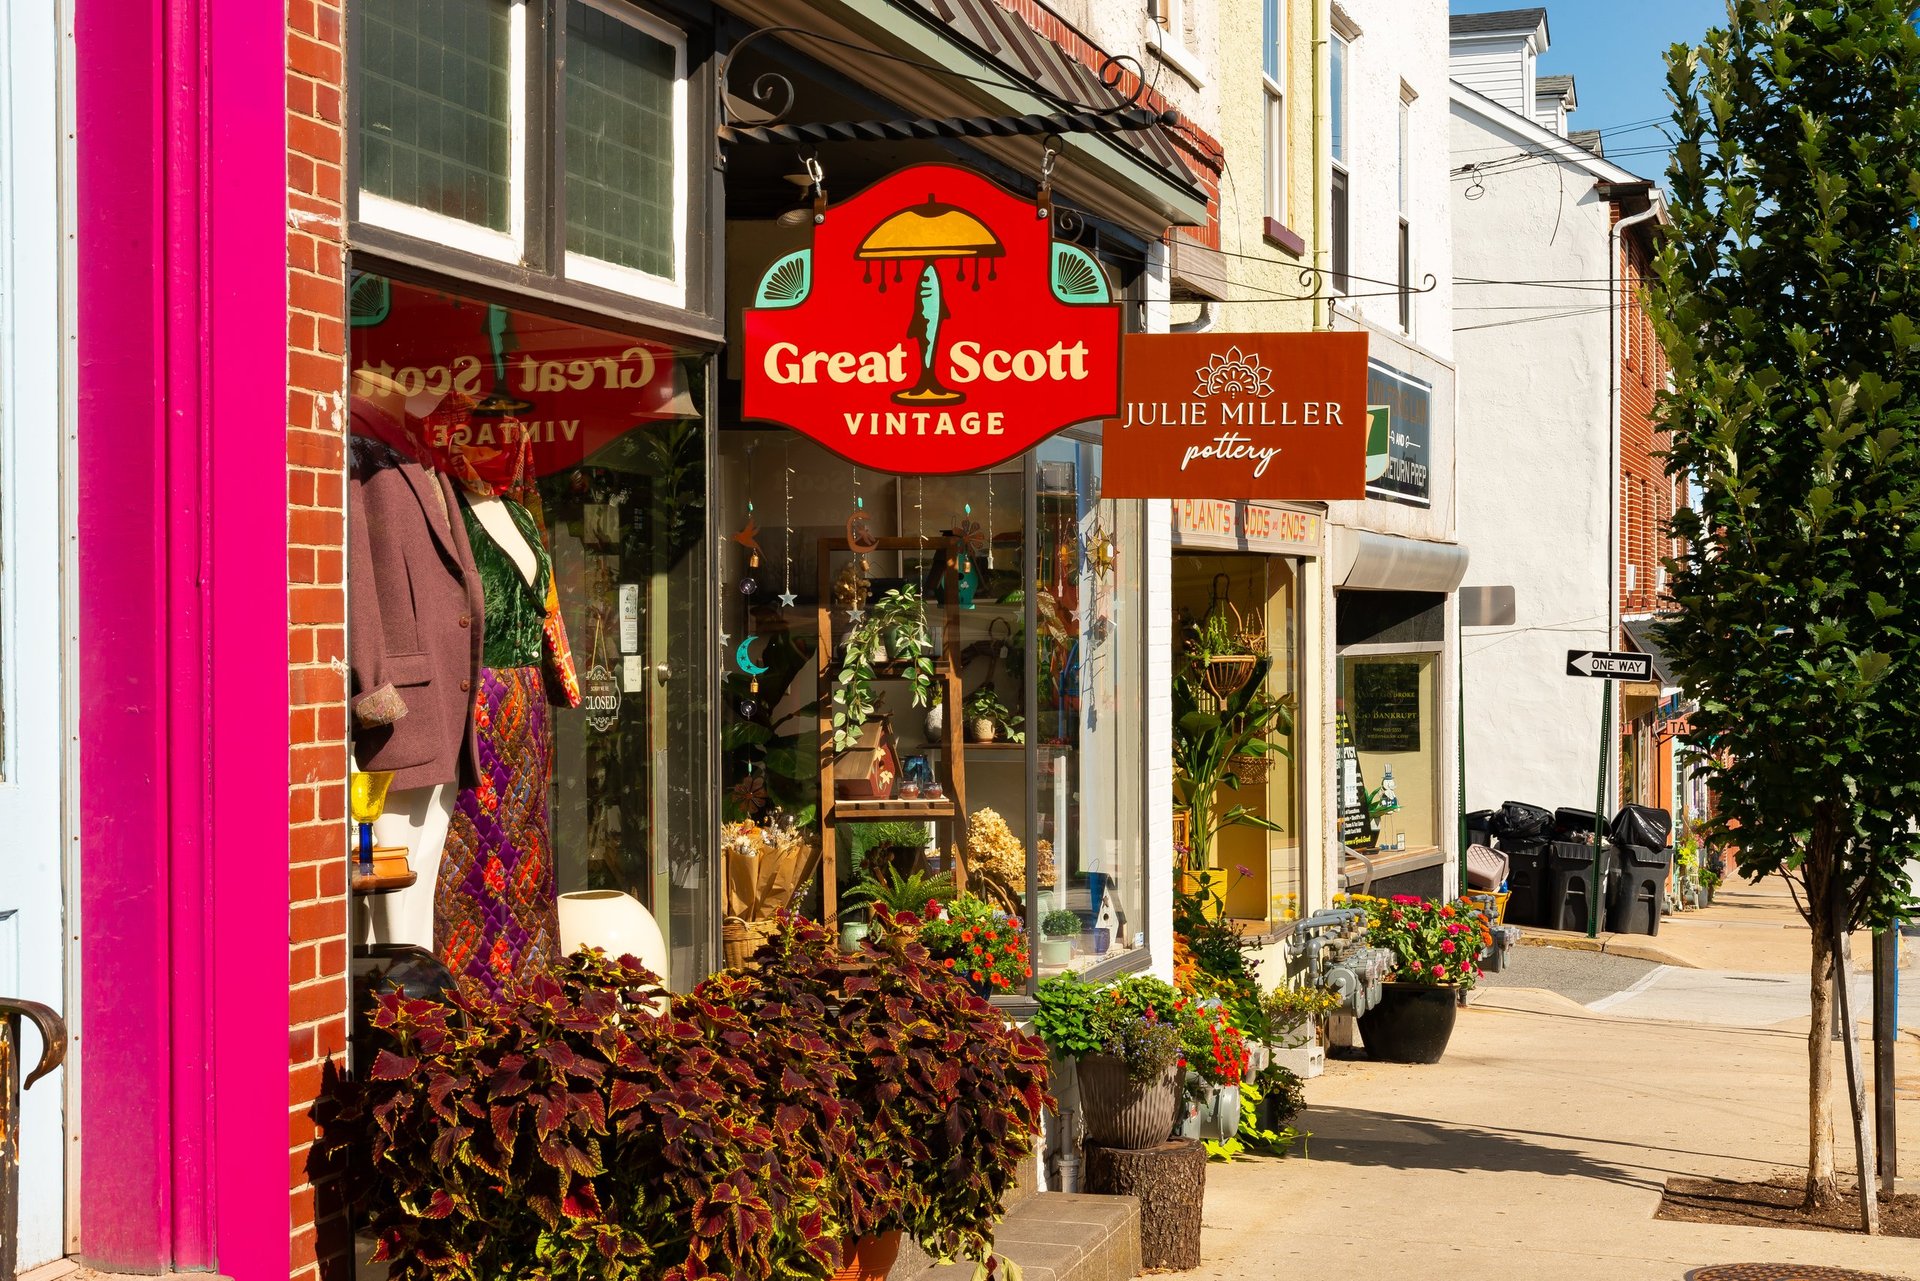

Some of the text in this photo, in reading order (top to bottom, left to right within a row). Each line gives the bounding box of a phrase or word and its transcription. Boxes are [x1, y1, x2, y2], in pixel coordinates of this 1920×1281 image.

[763, 340, 1089, 385] Great Scott
[843, 411, 1005, 436] VINTAGE
[1122, 401, 1207, 428] JULIE
[1220, 401, 1344, 426] MILLER
[1395, 432, 1405, 447] AND
[1180, 431, 1282, 478] pottery
[1410, 462, 1427, 488] PREP
[1184, 499, 1231, 535] PLANTS
[1243, 504, 1270, 538] ODDS
[1280, 511, 1306, 541] ENDS
[1591, 659, 1642, 673] ONE WAY
[585, 695, 617, 710] CLOSED
[1373, 711, 1417, 719] BANKRUPT
